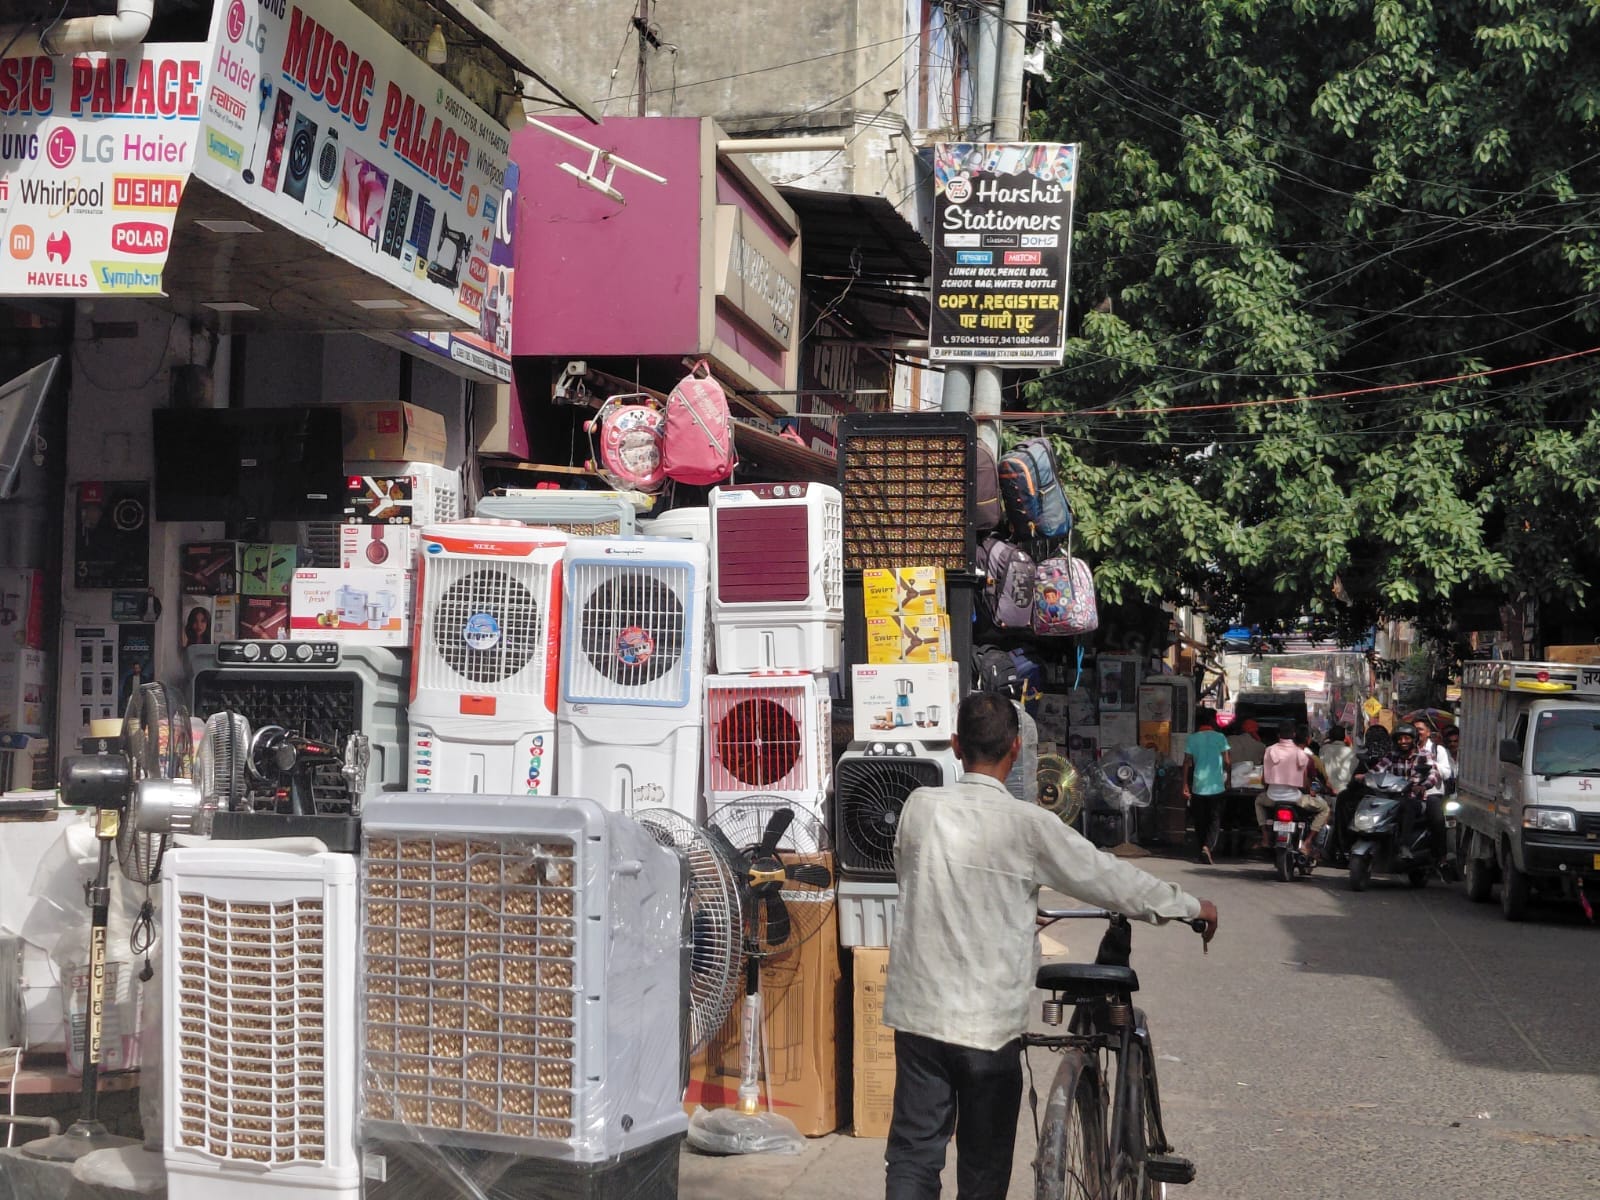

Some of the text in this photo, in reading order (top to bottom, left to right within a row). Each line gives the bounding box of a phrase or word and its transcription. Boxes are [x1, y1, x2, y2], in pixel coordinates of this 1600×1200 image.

[245, 15, 267, 54] LG
[217, 45, 256, 92] Haier
[70, 57, 201, 117] PALACE
[282, 5, 470, 195] MUSIC PALACE
[81, 134, 114, 163] LG
[123, 134, 188, 162] Haier
[20, 179, 104, 213] Whirlpool
[117, 182, 178, 203] USHA
[976, 179, 1063, 203] Harshit
[942, 204, 1062, 231] Stationers
[116, 229, 163, 247] POLAR
[27, 272, 88, 287] HAVELLS
[949, 267, 976, 276] LUNCH
[941, 280, 973, 289] SCHOOL
[1025, 280, 1057, 289] BOTTLE
[939, 294, 979, 308] COPY
[960, 314, 978, 329] पर
